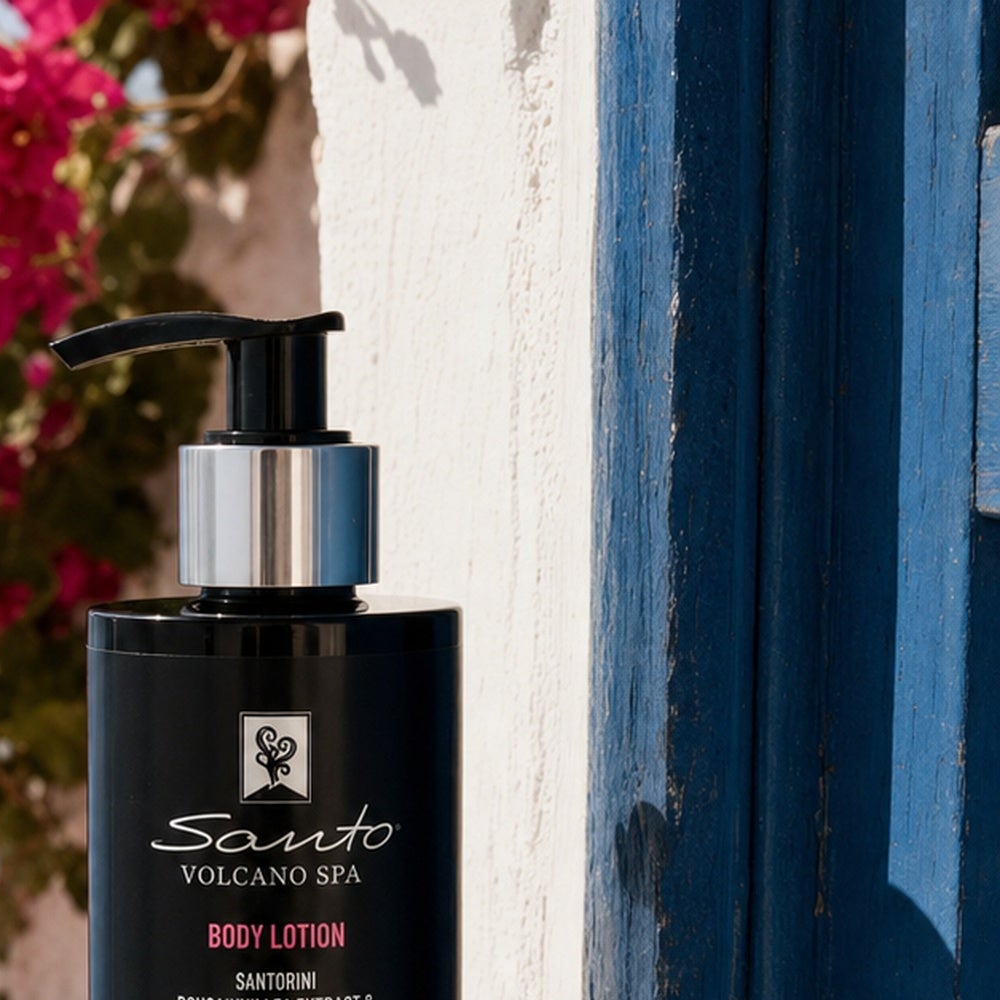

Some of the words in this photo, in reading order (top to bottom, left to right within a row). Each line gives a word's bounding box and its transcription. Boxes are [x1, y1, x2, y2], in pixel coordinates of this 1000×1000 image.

[151, 804, 393, 853] Santo
[181, 865, 306, 886] VOLCANO
[317, 865, 361, 886] SPA
[208, 923, 263, 949] BODY
[271, 922, 344, 949] LOTION
[236, 971, 316, 991] SANTORINI
